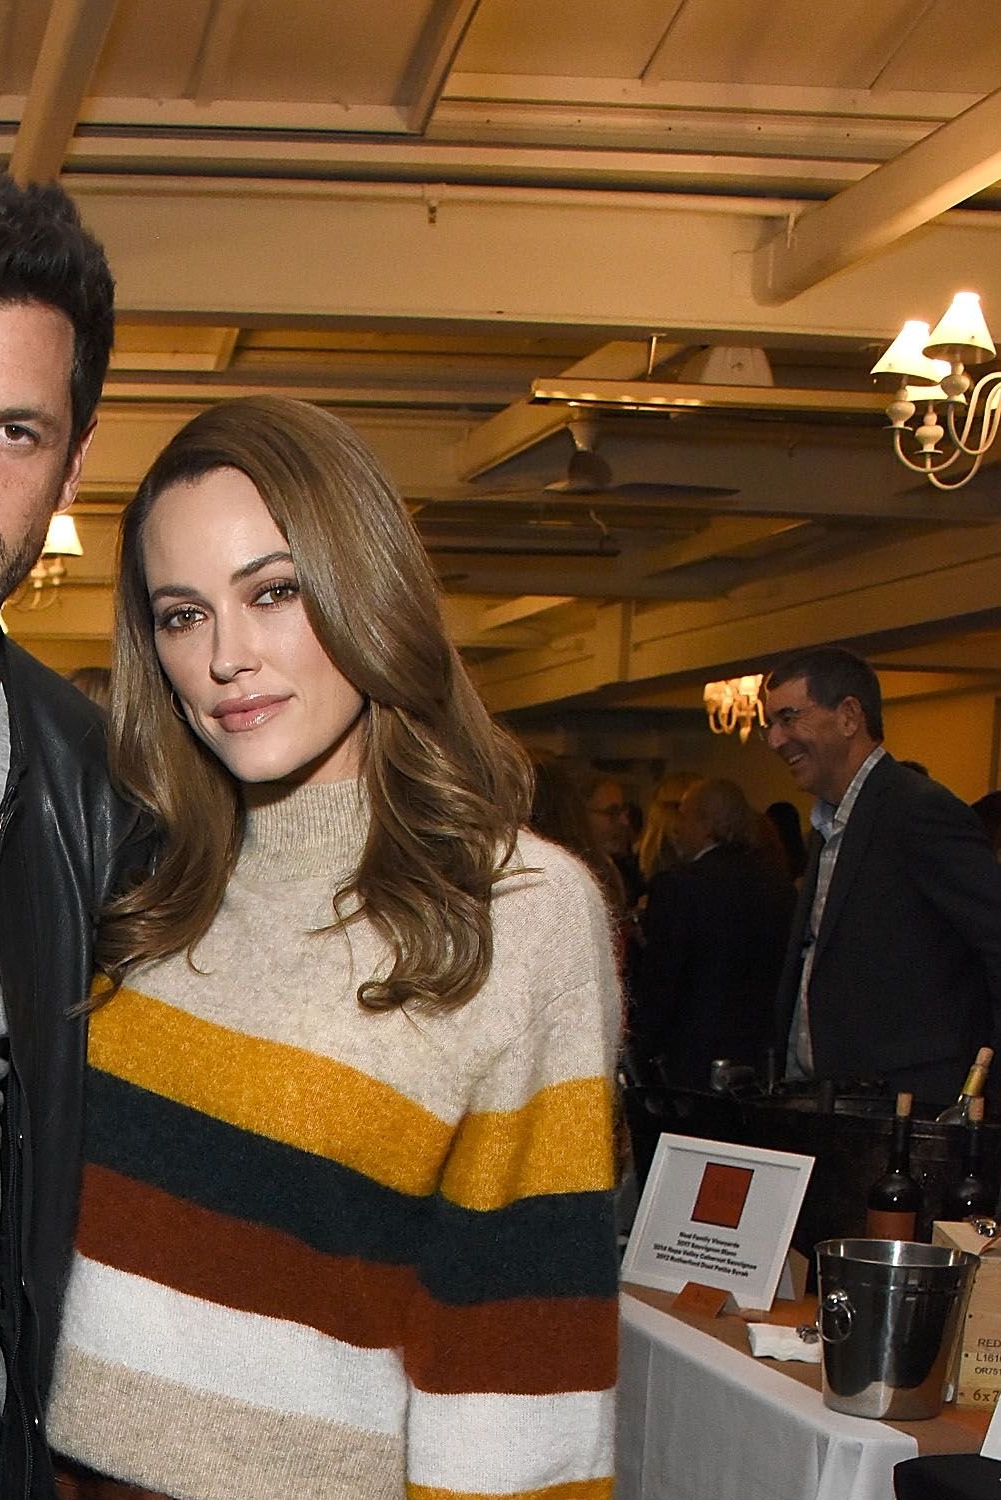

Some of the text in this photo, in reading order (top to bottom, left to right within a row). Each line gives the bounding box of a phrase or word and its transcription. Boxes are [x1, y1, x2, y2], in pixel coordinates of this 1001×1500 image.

[693, 1233, 711, 1243] Family
[691, 1242, 720, 1252] Sauvignon
[683, 1250, 699, 1259] Valley
[727, 1258, 757, 1270] Sauvignon
